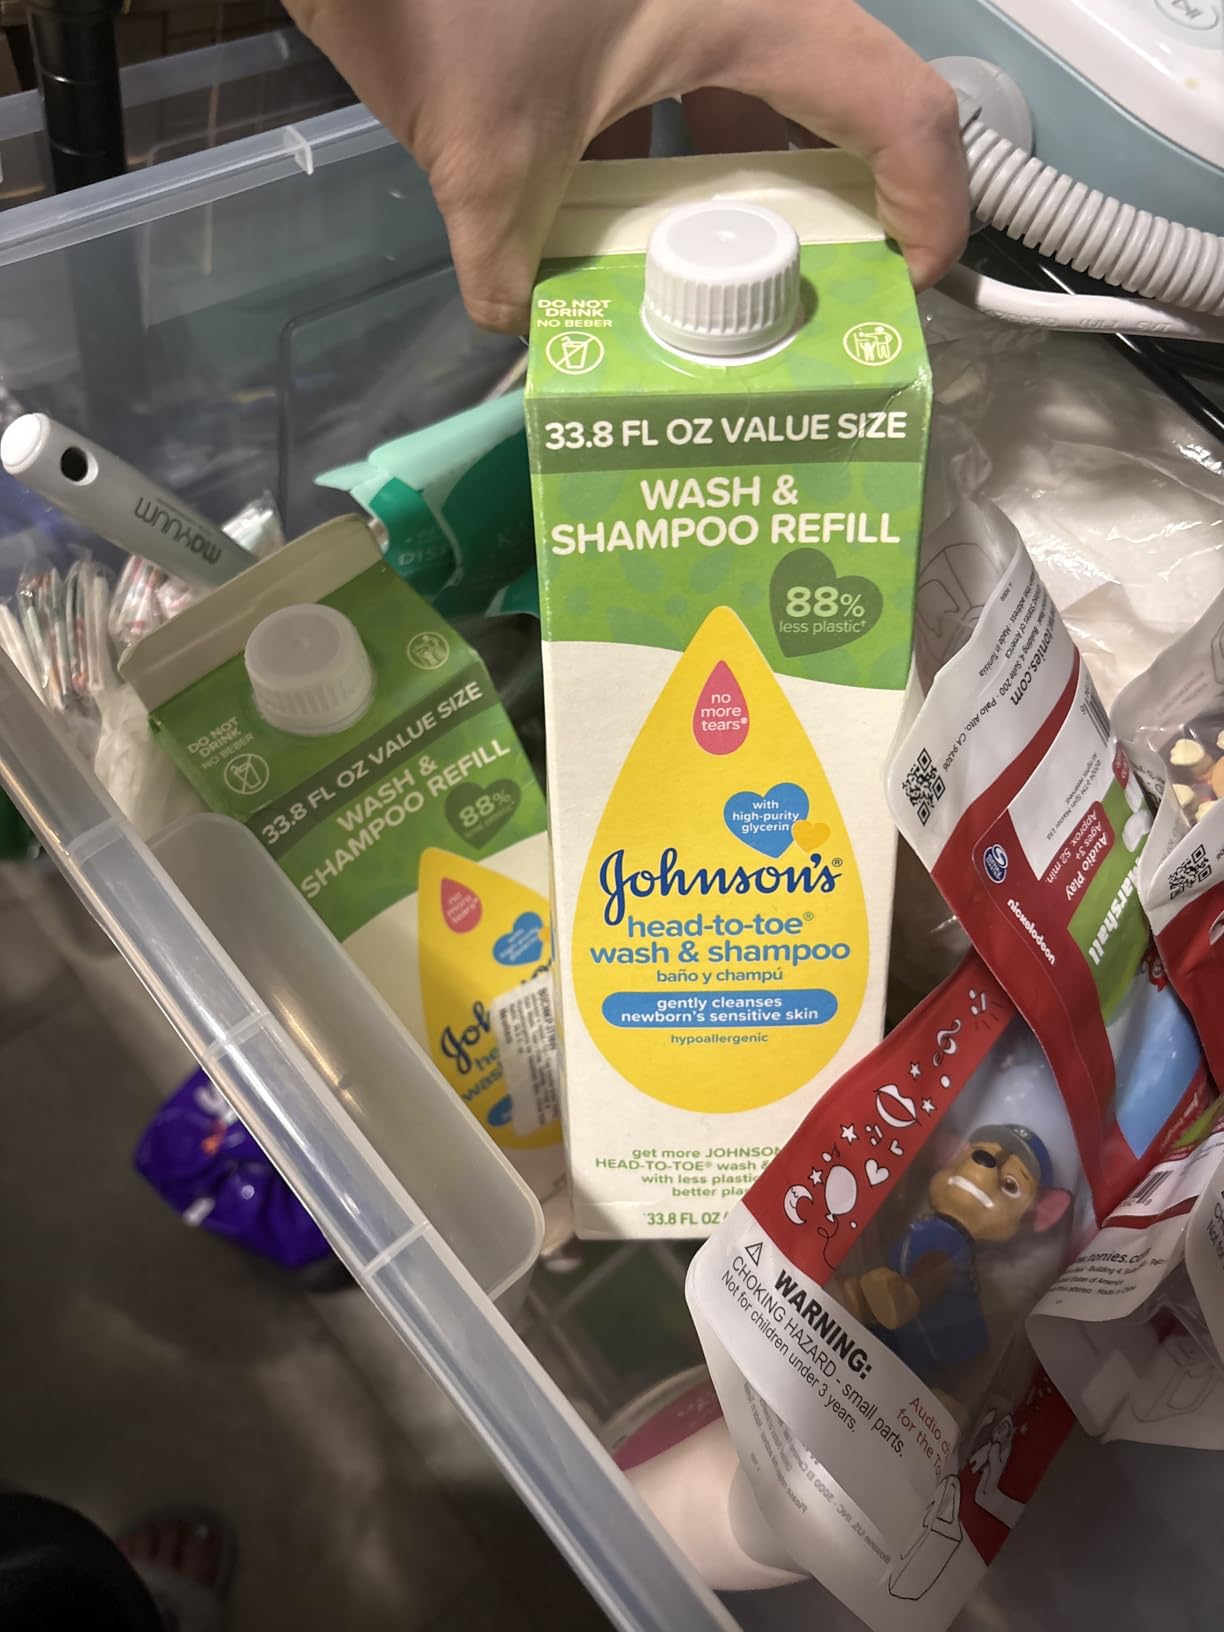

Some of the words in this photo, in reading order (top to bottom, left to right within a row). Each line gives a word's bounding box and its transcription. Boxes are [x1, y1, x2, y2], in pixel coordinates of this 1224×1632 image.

[538, 300, 568, 309] DO
[572, 299, 611, 309] NOT
[545, 307, 604, 318] DRINK
[536, 320, 560, 329] NO
[563, 318, 613, 329] BEBER
[545, 421, 613, 450] 33.8
[622, 419, 659, 447] FL
[666, 418, 713, 446] OZ
[721, 414, 829, 444] VALUE
[837, 412, 909, 440] SIZE
[640, 476, 760, 511] WASH
[772, 474, 799, 506] &
[551, 513, 759, 555] SHAMPOO
[771, 512, 901, 545] REFILL
[785, 586, 866, 618] 88%
[1010, 597, 1025, 623] address
[1023, 603, 1037, 623] States
[779, 620, 809, 633] less
[999, 625, 1012, 645] Made
[1019, 623, 1026, 634] of
[995, 643, 1003, 653] in
[1005, 629, 1022, 660] America
[1022, 626, 1040, 655] Building
[978, 654, 999, 677] Tunisia
[1009, 660, 1022, 680] Suite
[1000, 678, 1012, 696] 200
[711, 693, 731, 705] no
[980, 697, 997, 715] Palo
[701, 705, 742, 718] more
[187, 736, 209, 753] DO
[210, 716, 238, 740] NOT
[199, 727, 241, 757] DRINK
[956, 733, 967, 746] CA
[201, 756, 219, 769] NO
[219, 733, 254, 759] BEBER
[261, 803, 308, 846] 33.8
[307, 785, 337, 811] FL
[336, 761, 370, 789] OZ
[368, 711, 437, 767] VALUE
[438, 681, 484, 720] SIZE
[336, 772, 416, 833] WASH
[418, 755, 440, 777] &
[459, 789, 512, 828] 88%
[752, 800, 779, 810] with
[300, 791, 425, 900] SHAMPOO
[428, 739, 511, 798] REFILL
[732, 811, 800, 823] high-purity
[1055, 807, 1072, 829] Master
[741, 822, 790, 834] glycerin
[1083, 821, 1102, 847] Ages
[1059, 849, 1072, 868] 52
[1073, 845, 1086, 861] 3+
[1082, 831, 1109, 872] Audio
[1065, 871, 1086, 901] play
[1007, 898, 1056, 966] nickelodeon
[590, 941, 669, 964] wash
[678, 940, 699, 963] &
[708, 940, 850, 966] shampoo
[657, 969, 698, 983] baño
[702, 971, 712, 984] y
[716, 967, 783, 984] champú
[656, 998, 708, 1012] gently
[712, 996, 783, 1009] cleanses
[621, 1010, 705, 1024] newborn's
[710, 1009, 781, 1022] sensitive
[785, 1008, 819, 1020] skin
[671, 1032, 769, 1045] hypoallergenic
[632, 1148, 657, 1160] get
[662, 1149, 700, 1158] more
[716, 1160, 757, 1171] wash
[641, 1174, 673, 1184] with
[678, 1174, 707, 1184] less
[672, 1187, 717, 1196] better
[721, 1186, 747, 1198] pla
[647, 1212, 677, 1225] 33.8
[680, 1212, 698, 1225] FL
[701, 1212, 721, 1225] OZ
[773, 1269, 873, 1380] WARNING:
[721, 1270, 738, 1296] Not
[737, 1292, 752, 1314] for
[750, 1311, 788, 1356] children
[788, 1351, 821, 1390] under
[817, 1383, 828, 1398] 3
[823, 1396, 857, 1433] years.
[731, 1256, 787, 1323] CHOKING
[783, 1316, 837, 1378] HAZARD
[841, 1383, 877, 1418] small
[871, 1418, 905, 1457] parts.
[909, 1397, 942, 1440] Audio
[896, 1408, 917, 1432] for
[915, 1430, 934, 1459] the
